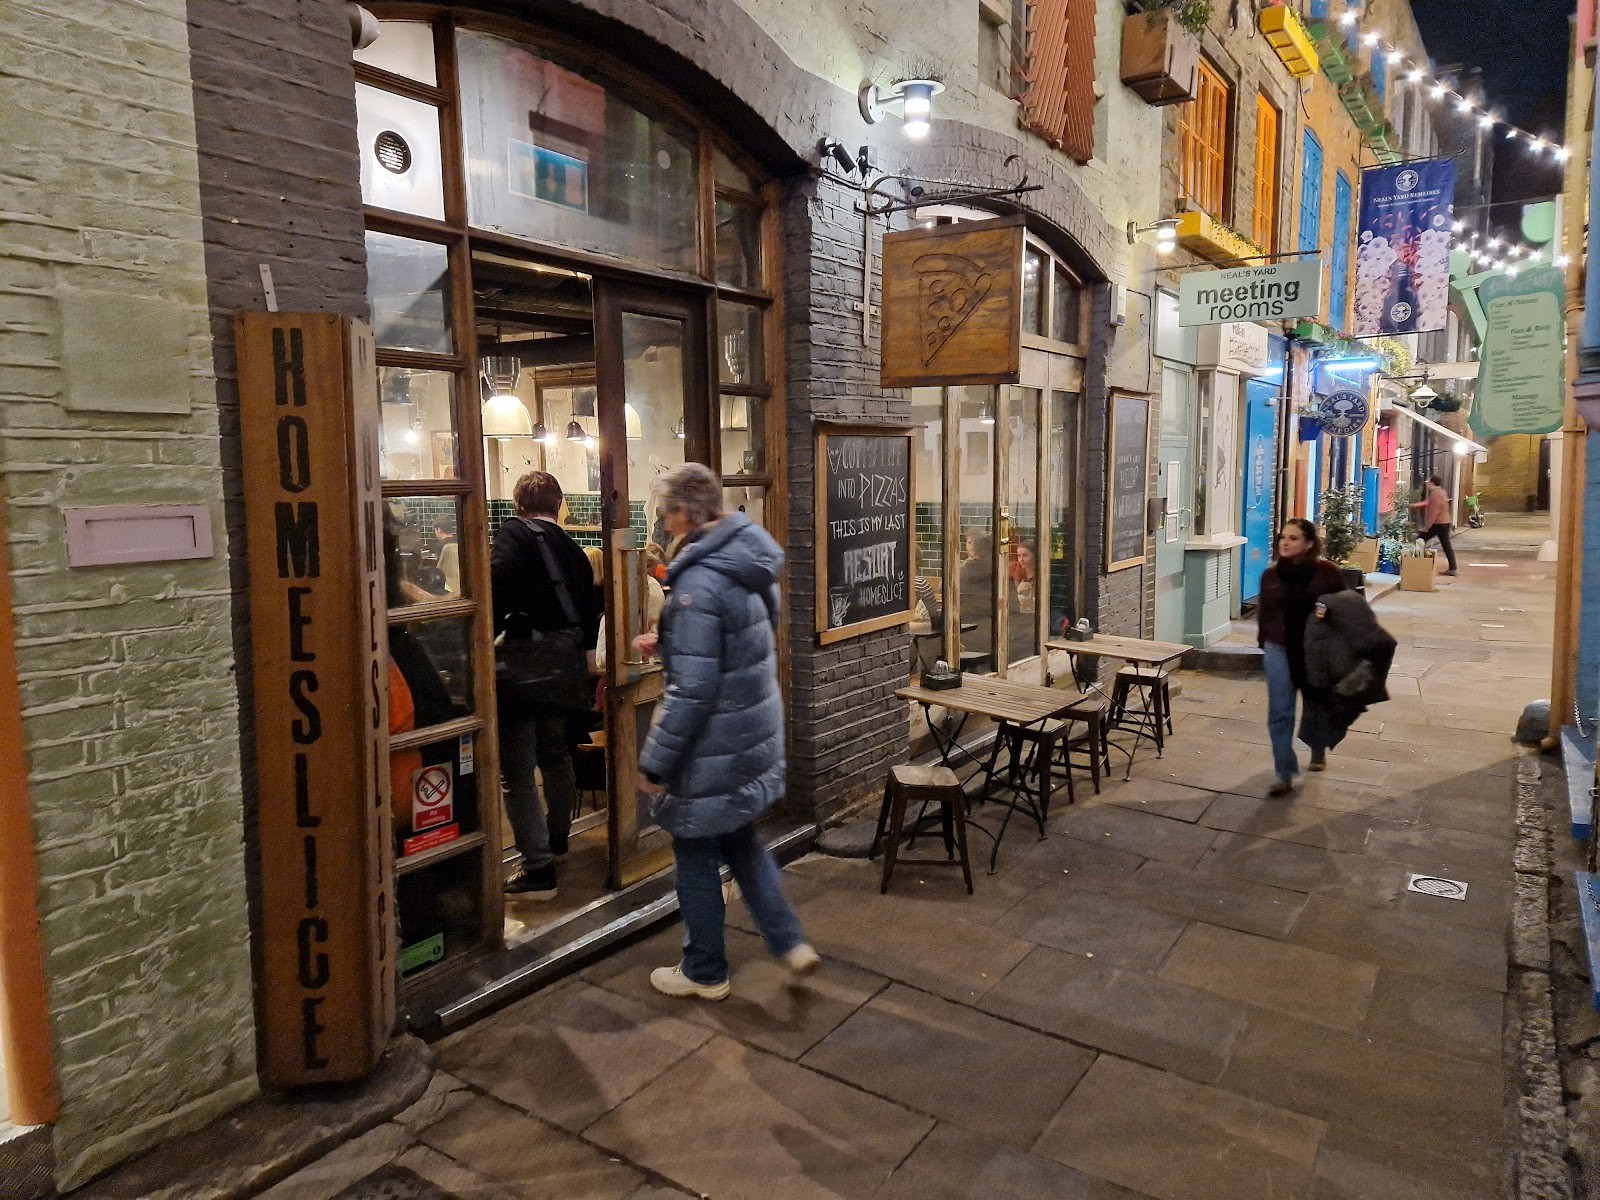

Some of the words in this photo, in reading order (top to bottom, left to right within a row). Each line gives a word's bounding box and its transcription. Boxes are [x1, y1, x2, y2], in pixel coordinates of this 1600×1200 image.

[1220, 269, 1251, 280] NEAL'S
[1253, 267, 1277, 277] YARD
[1197, 279, 1300, 305] meeting
[1210, 300, 1284, 321] rooms
[1349, 394, 1365, 412] YARD
[838, 478, 856, 499] INTO
[858, 472, 907, 509] PIZZAS
[829, 518, 857, 540] THIS
[857, 517, 870, 535] IS
[871, 514, 883, 532] MY
[884, 513, 906, 531] LAST
[843, 540, 898, 589] RESORT
[857, 581, 905, 608] HOMESLICE
[272, 327, 329, 1070] HOMESLICE
